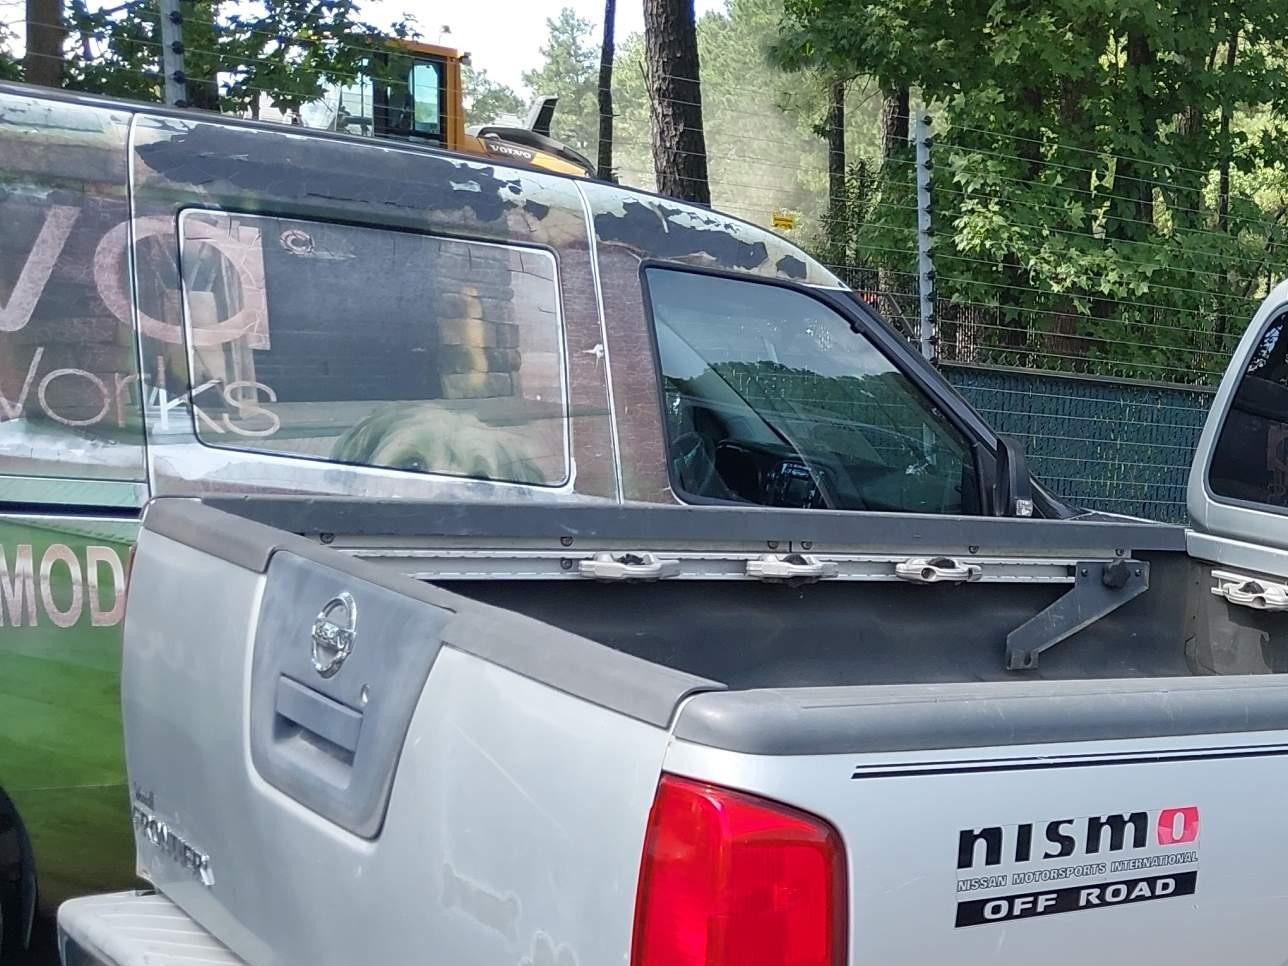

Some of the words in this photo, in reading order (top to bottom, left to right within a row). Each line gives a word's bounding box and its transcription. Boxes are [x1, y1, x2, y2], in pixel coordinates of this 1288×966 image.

[489, 143, 532, 159] VOLVO
[0, 543, 136, 628] MOD
[957, 874, 1007, 892] NISSAN
[1012, 862, 1107, 886] MOTORSPORTS
[1111, 850, 1199, 873] INTERNATIONAL
[983, 893, 1058, 920] OFF
[1079, 877, 1177, 907] ROAD
